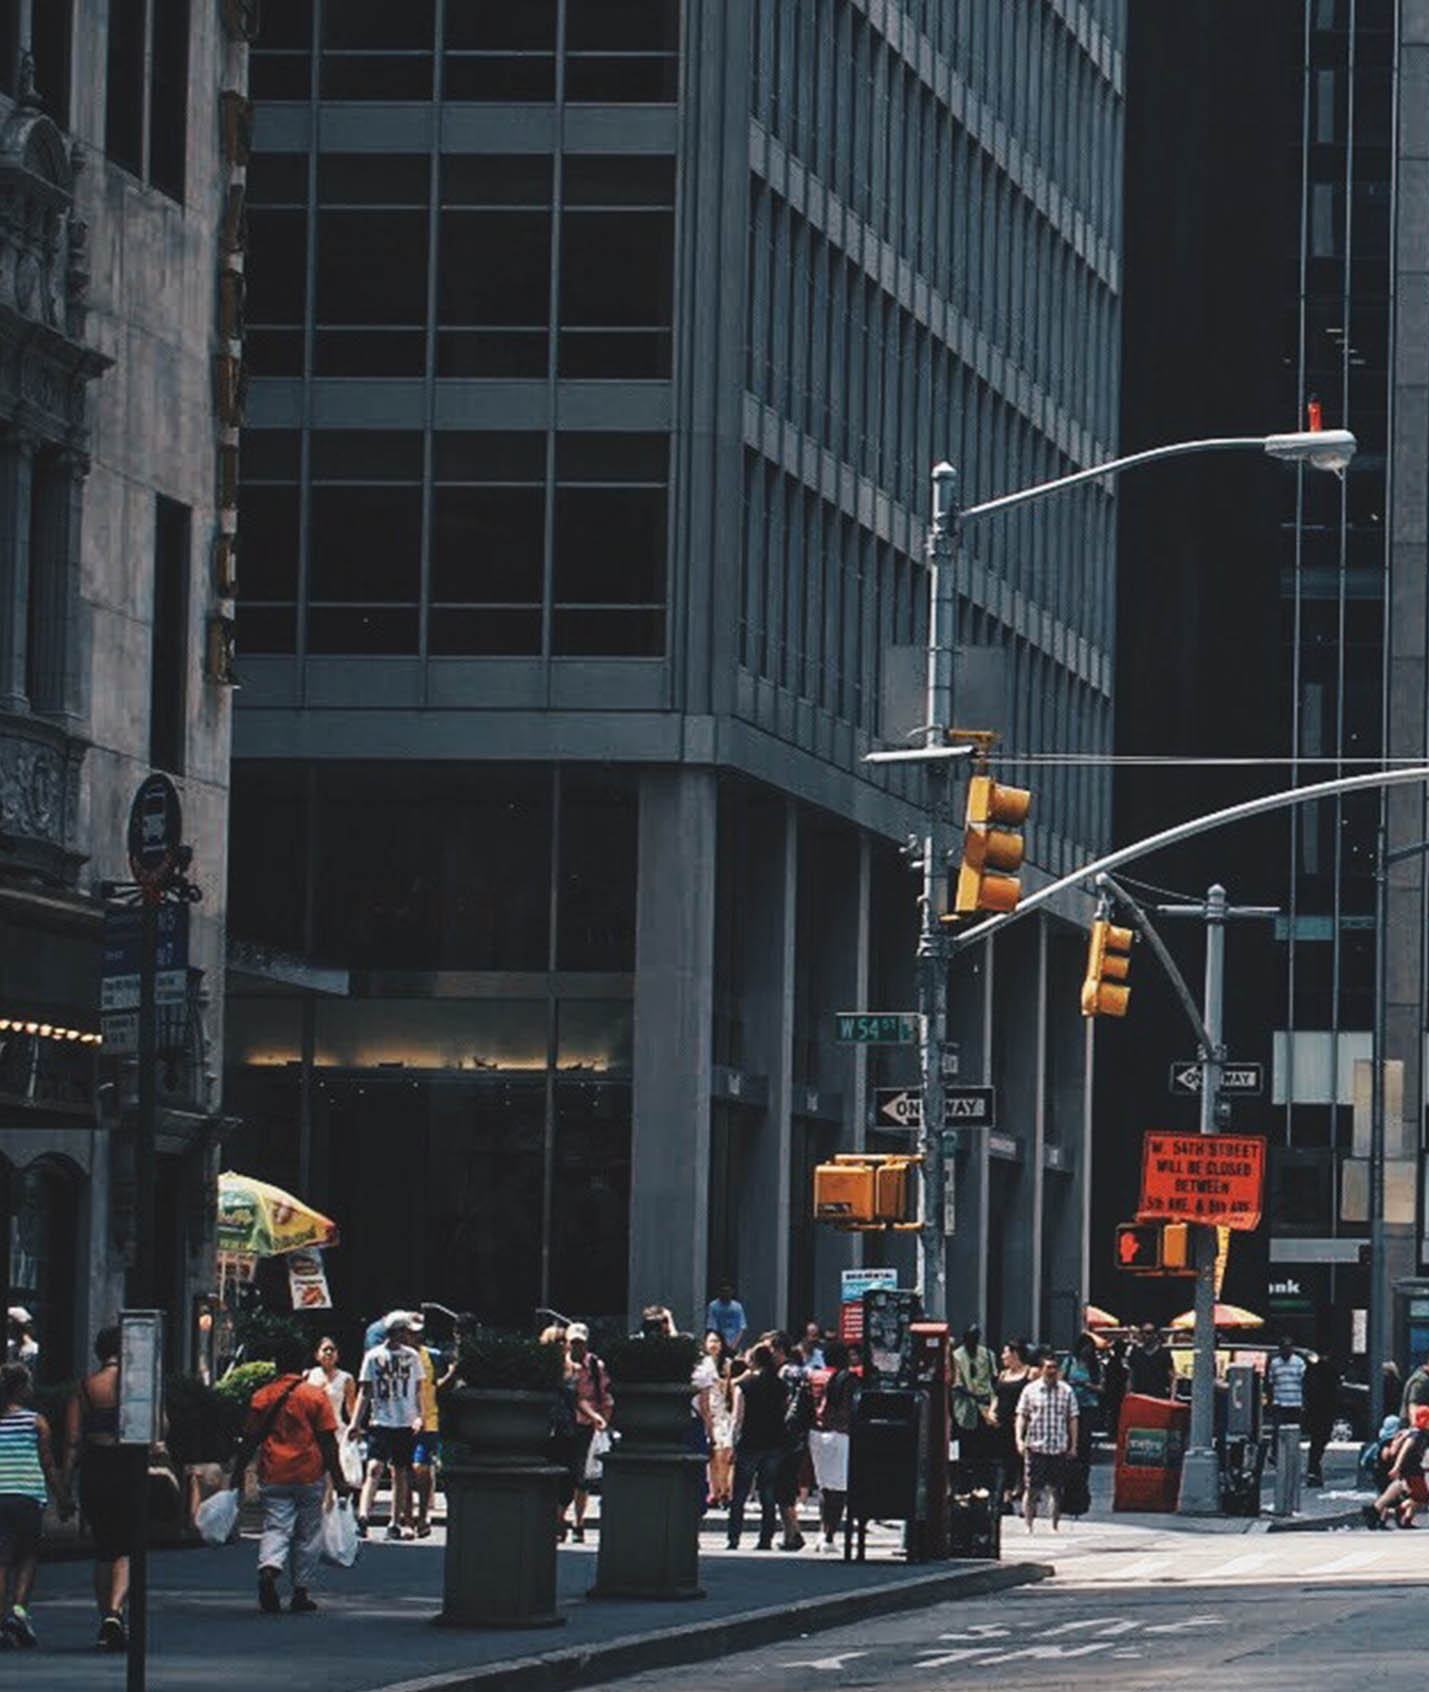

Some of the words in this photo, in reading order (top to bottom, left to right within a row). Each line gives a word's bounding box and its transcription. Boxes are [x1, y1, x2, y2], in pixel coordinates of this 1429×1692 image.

[840, 1019, 854, 1040] W
[857, 1019, 880, 1040] 54
[1188, 1162, 1202, 1175] BE
[1206, 1163, 1252, 1177] CLOSED
[1175, 1179, 1230, 1195] BETWEEN
